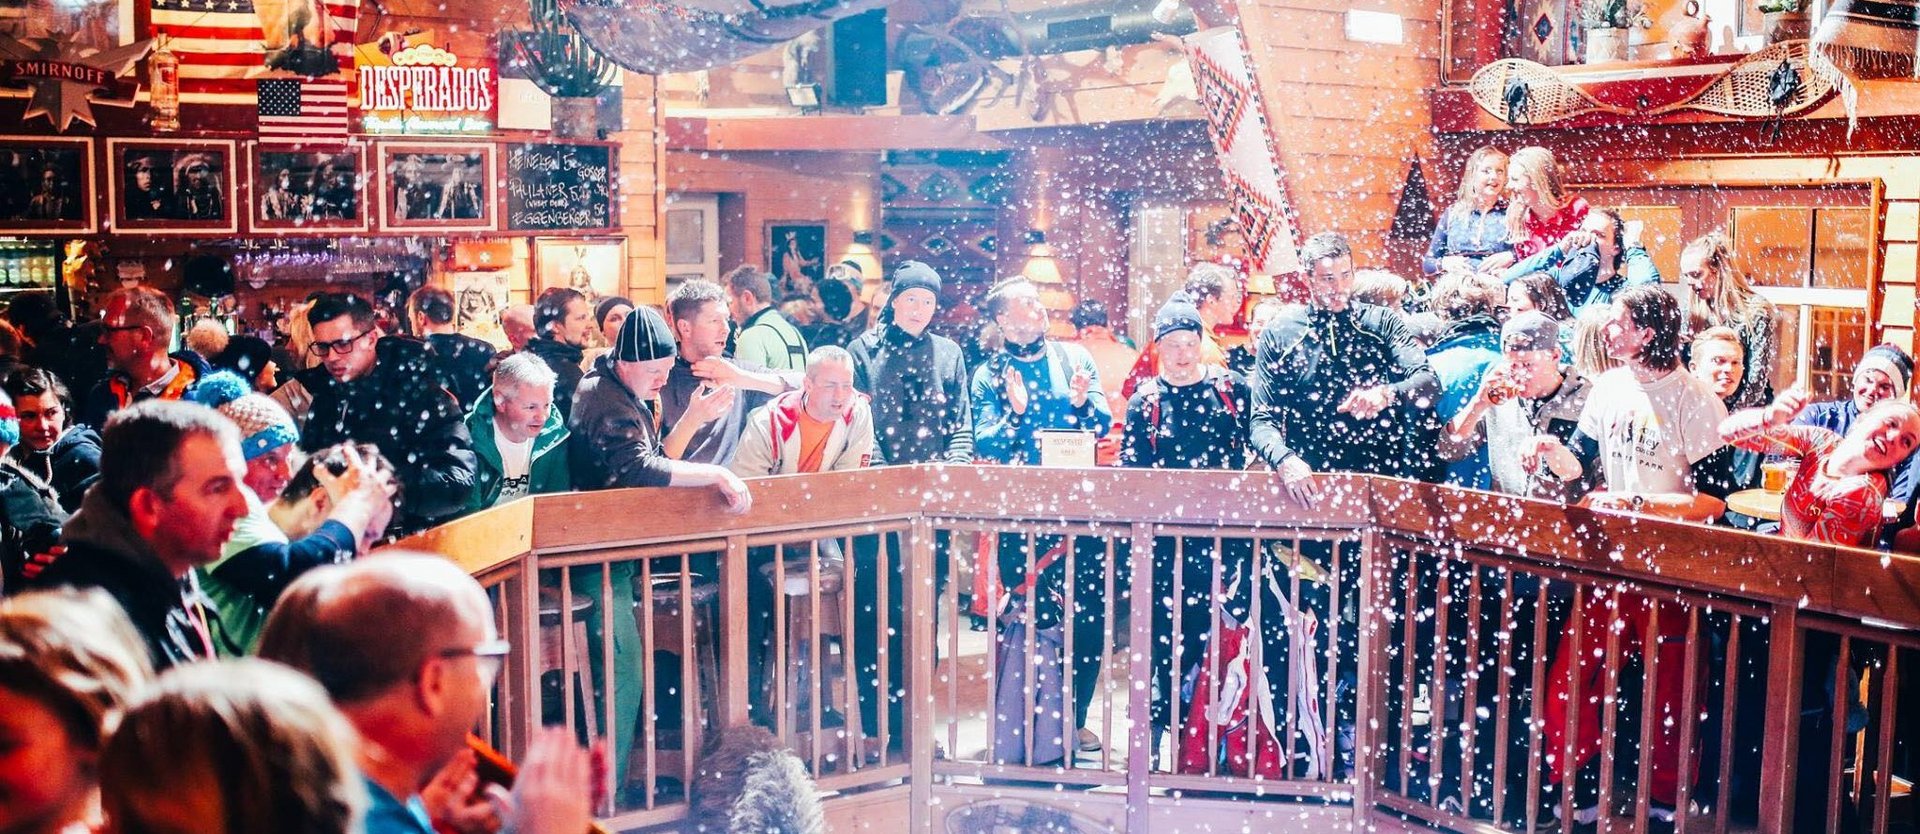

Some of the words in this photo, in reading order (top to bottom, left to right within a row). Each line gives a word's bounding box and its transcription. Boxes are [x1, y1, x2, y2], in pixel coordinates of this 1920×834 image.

[16, 61, 105, 84] SMIRNOFF
[359, 65, 492, 111] DESPERADOS
[512, 208, 591, 226] EGGENBERGER
[1639, 459, 1664, 471] PARK
